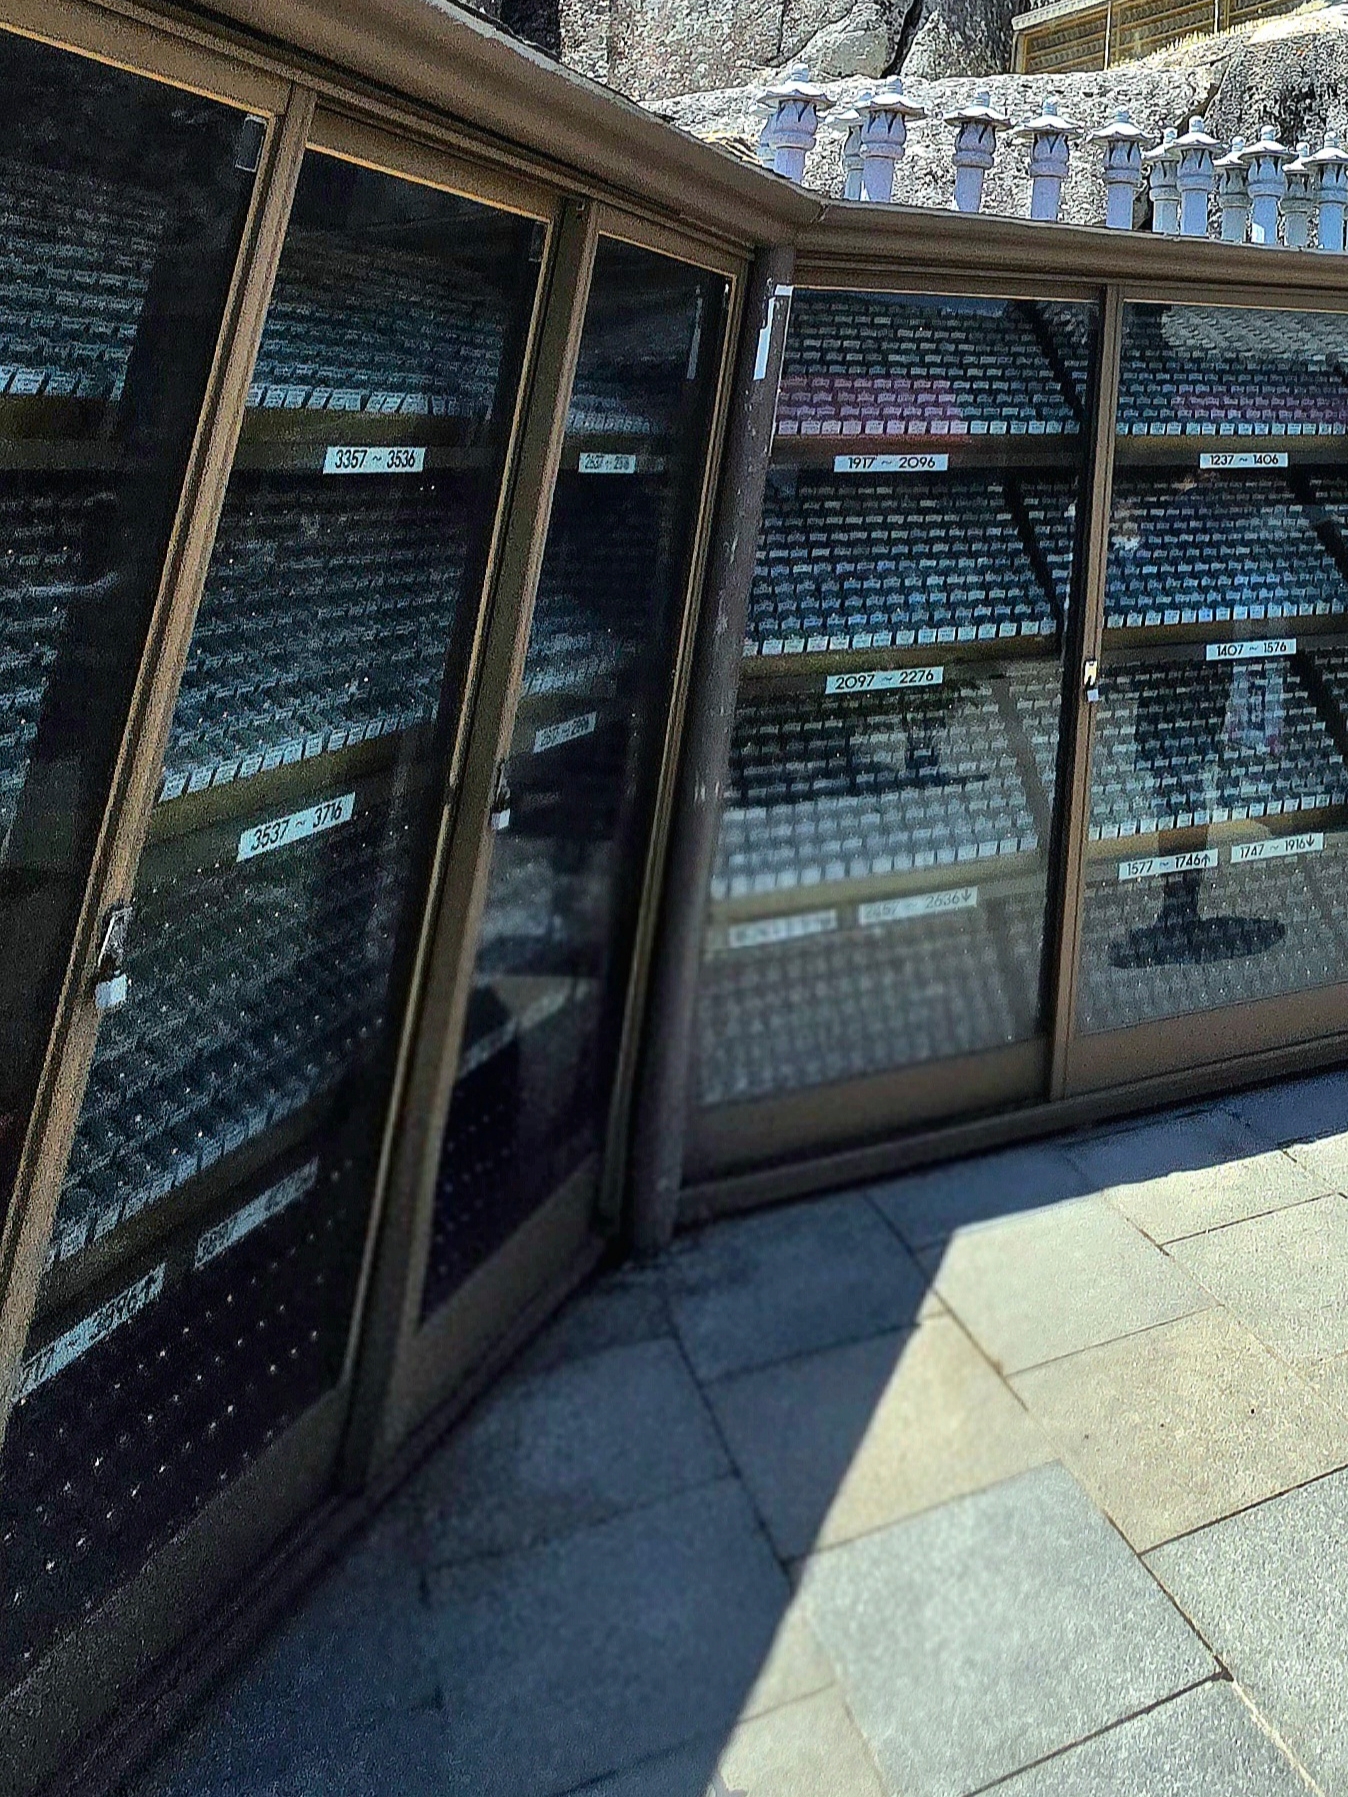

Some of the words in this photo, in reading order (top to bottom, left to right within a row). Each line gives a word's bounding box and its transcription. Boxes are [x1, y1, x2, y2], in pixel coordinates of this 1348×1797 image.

[334, 449, 368, 469] 3357
[386, 449, 416, 469] 3536
[847, 456, 875, 470] 1917
[898, 456, 936, 470] 2096
[1209, 454, 1235, 466] 1237
[1252, 453, 1279, 465] 1406
[1215, 644, 1243, 657] 1407
[1263, 641, 1287, 654] 1576
[835, 674, 875, 691] 2097
[899, 668, 934, 685] 2276
[250, 818, 291, 851] 3537
[312, 801, 343, 828] 3716
[1239, 844, 1264, 859] 1747
[1283, 837, 1306, 852] 1916
[1126, 860, 1153, 876] 1577
[1174, 853, 1201, 869] 1746
[924, 890, 961, 909] 2636
